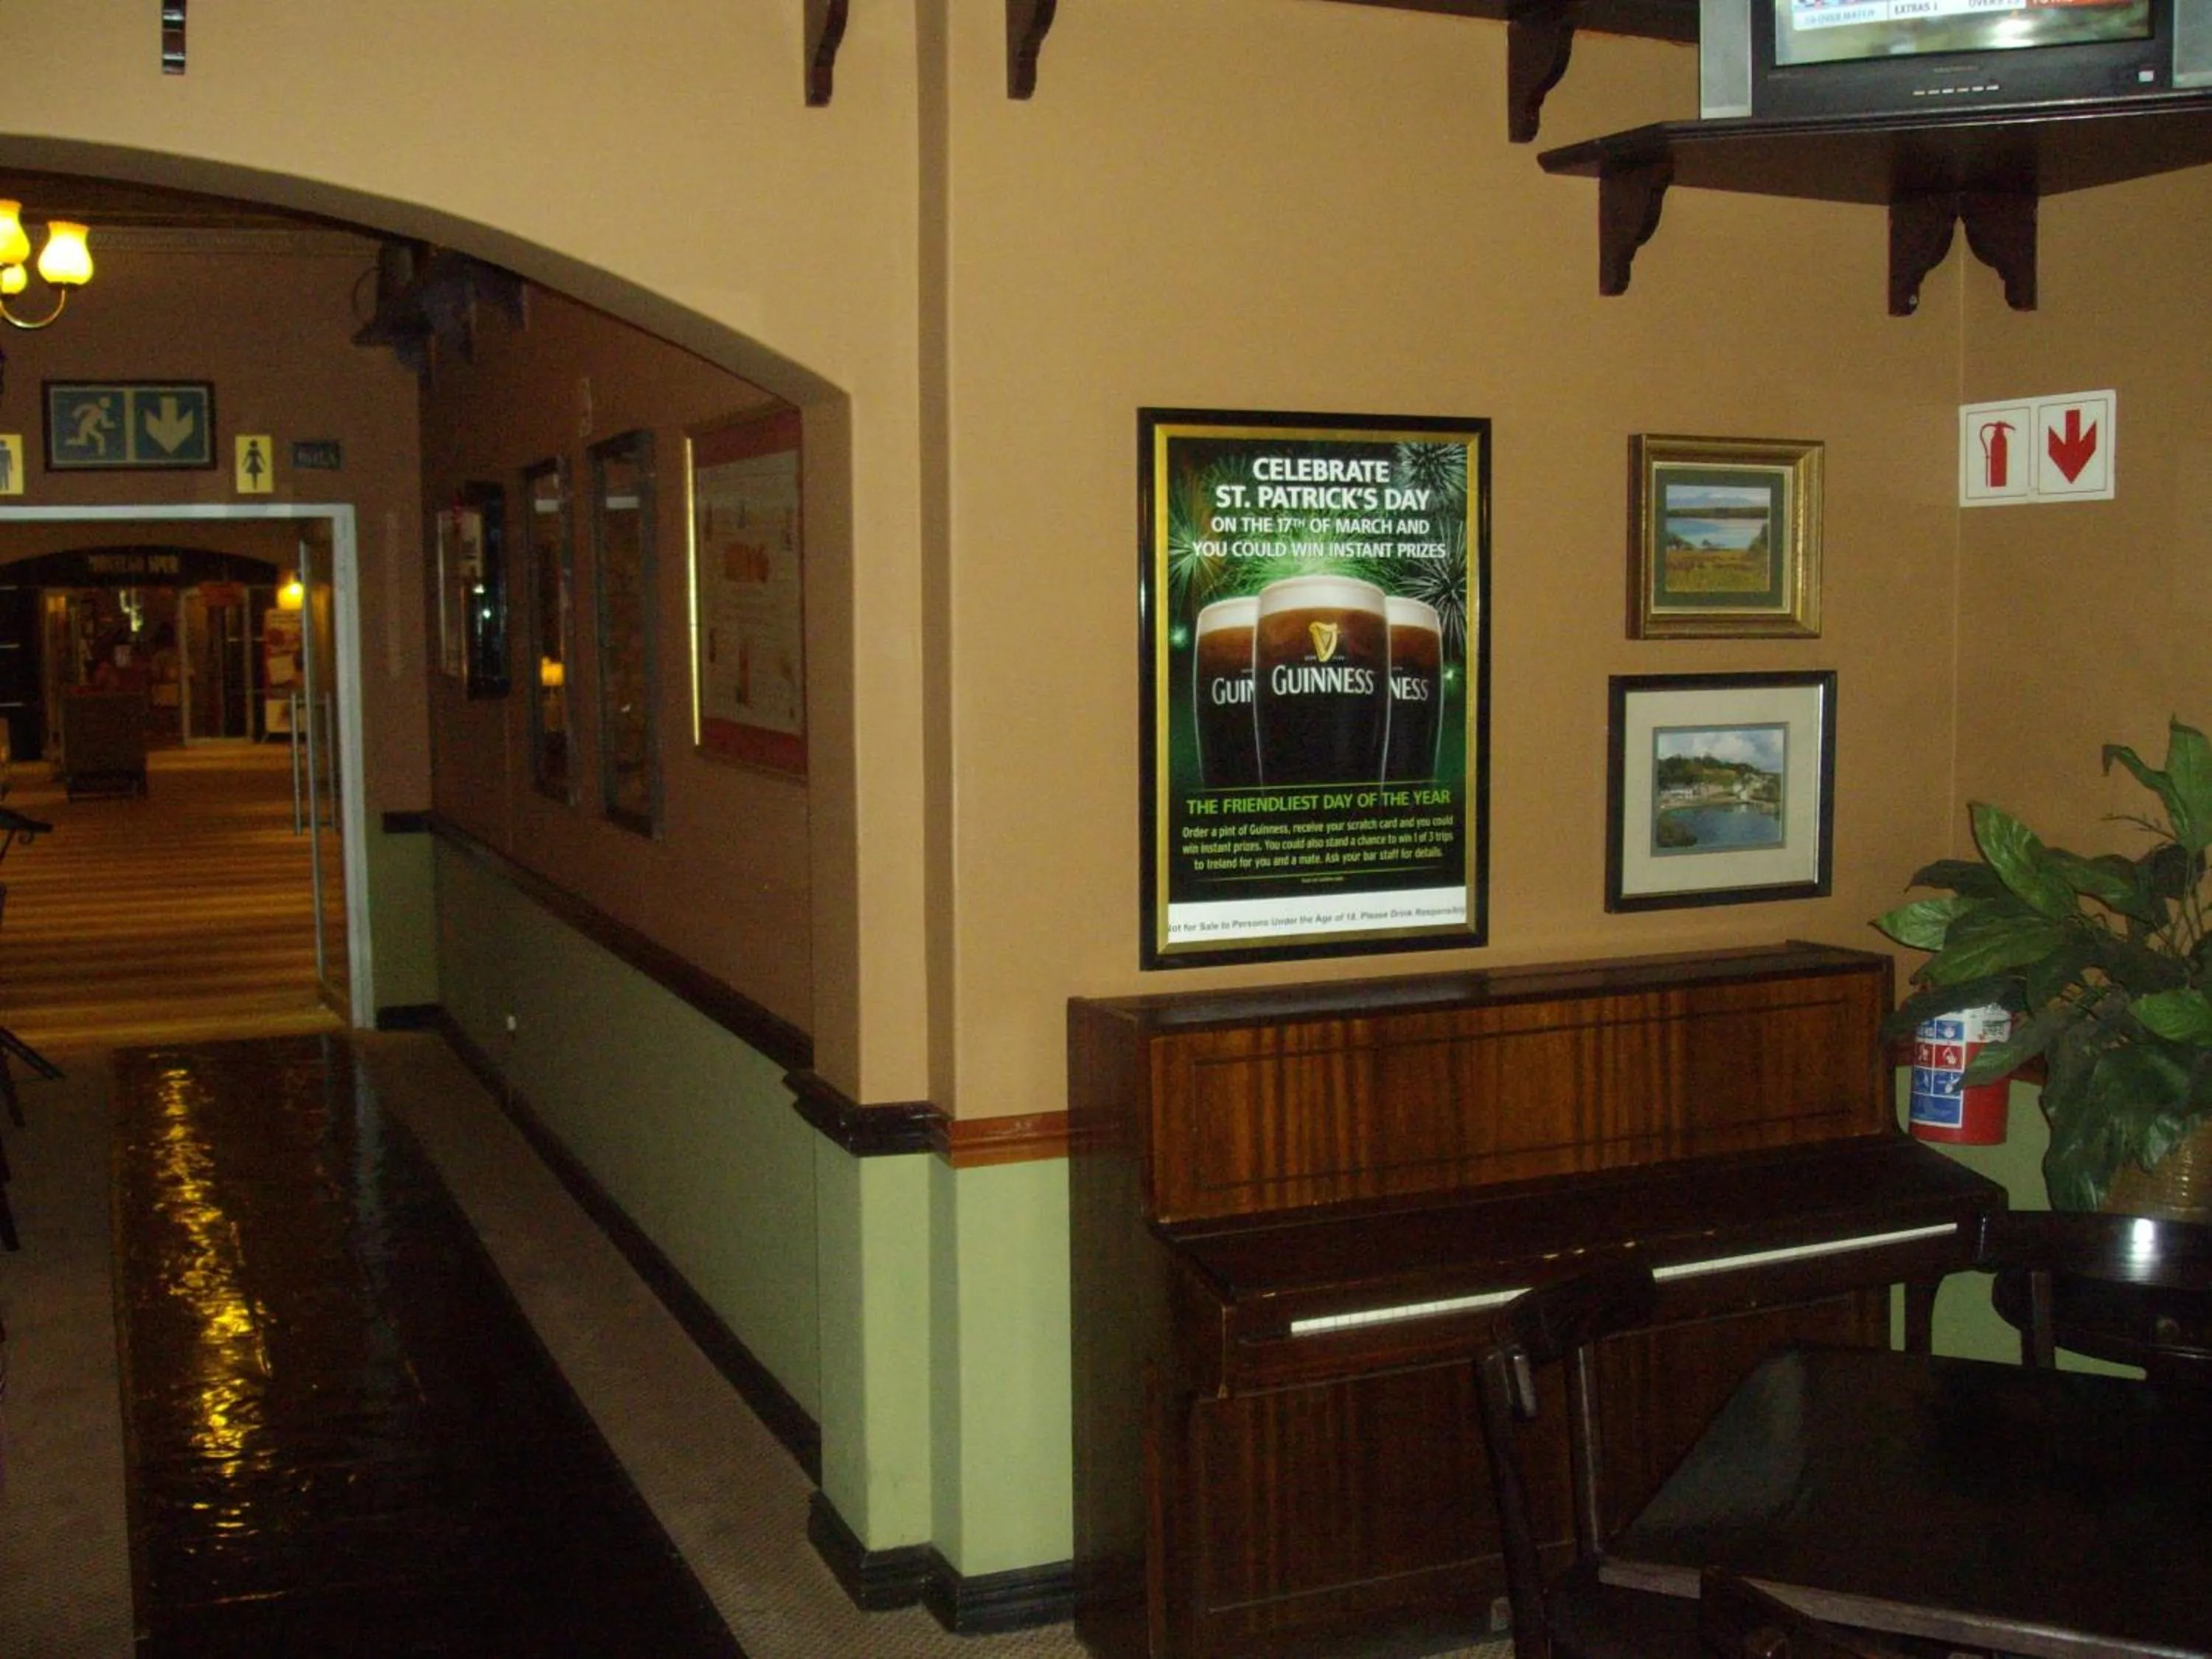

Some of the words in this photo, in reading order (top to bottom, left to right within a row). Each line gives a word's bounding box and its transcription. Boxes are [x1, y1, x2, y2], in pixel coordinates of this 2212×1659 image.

[1253, 457, 1390, 483] CELEBRATE
[1216, 485, 1250, 509] ST.
[1259, 486, 1377, 510] PATRICK'S
[1385, 489, 1430, 511] DAY
[1211, 518, 1236, 533] ON
[1242, 518, 1273, 533] THE
[1278, 518, 1305, 533] 17TH
[1310, 518, 1330, 534] OF
[1336, 519, 1390, 535] MARCH
[1397, 520, 1430, 535] AND
[1193, 543, 1226, 557] YOU
[1232, 543, 1286, 557] COULD
[1293, 543, 1324, 557] WIN
[1330, 543, 1392, 558] INSTANT
[1397, 543, 1445, 558] PRIZES
[1272, 665, 1374, 695] GUINNESS
[1186, 799, 1218, 815] THE
[1223, 796, 1318, 813] FRIENDLIEST
[1324, 793, 1352, 810] DAY
[1357, 793, 1377, 808] OF
[1383, 791, 1410, 806] THE
[1413, 790, 1450, 804] YEAR
[1182, 827, 1208, 838] Order
[1219, 825, 1236, 838] pint
[1239, 824, 1248, 835] of
[1293, 822, 1324, 832] receive
[1326, 822, 1345, 834] your
[1347, 818, 1377, 830] scratch
[1379, 818, 1397, 829] card
[1399, 817, 1415, 827] and
[1416, 817, 1431, 828] you
[1433, 815, 1453, 827] could
[1182, 844, 1199, 855] win
[1201, 842, 1231, 854] instant
[1265, 839, 1281, 850] You
[1282, 838, 1304, 849] could
[1307, 837, 1324, 849] also
[1326, 835, 1349, 848] stand
[1350, 838, 1355, 846] a
[1357, 834, 1386, 846] chance
[1388, 834, 1397, 844] to
[1399, 833, 1412, 844] win
[1419, 832, 1427, 843] of
[1436, 830, 1454, 843] trips
[1194, 859, 1204, 870] to
[1206, 857, 1237, 869] Ireland
[1239, 856, 1252, 869] for
[1256, 858, 1271, 869] you
[1273, 855, 1289, 866] and
[1291, 856, 1297, 865] a
[1325, 852, 1340, 863] Ask
[1342, 852, 1361, 864] your
[1364, 849, 1377, 860] bar
[1380, 847, 1399, 860] staff
[1401, 848, 1413, 859] for
[1183, 923, 1197, 933] for
[1200, 921, 1219, 931] Sale
[1221, 920, 1230, 931] to
[1232, 919, 1269, 930] Persons
[1272, 917, 1298, 928] Under
[1299, 914, 1313, 925] the
[1316, 913, 1332, 925] Age
[1334, 913, 1344, 922] of
[1360, 910, 1388, 920] Please
[1390, 908, 1412, 919] Drink
